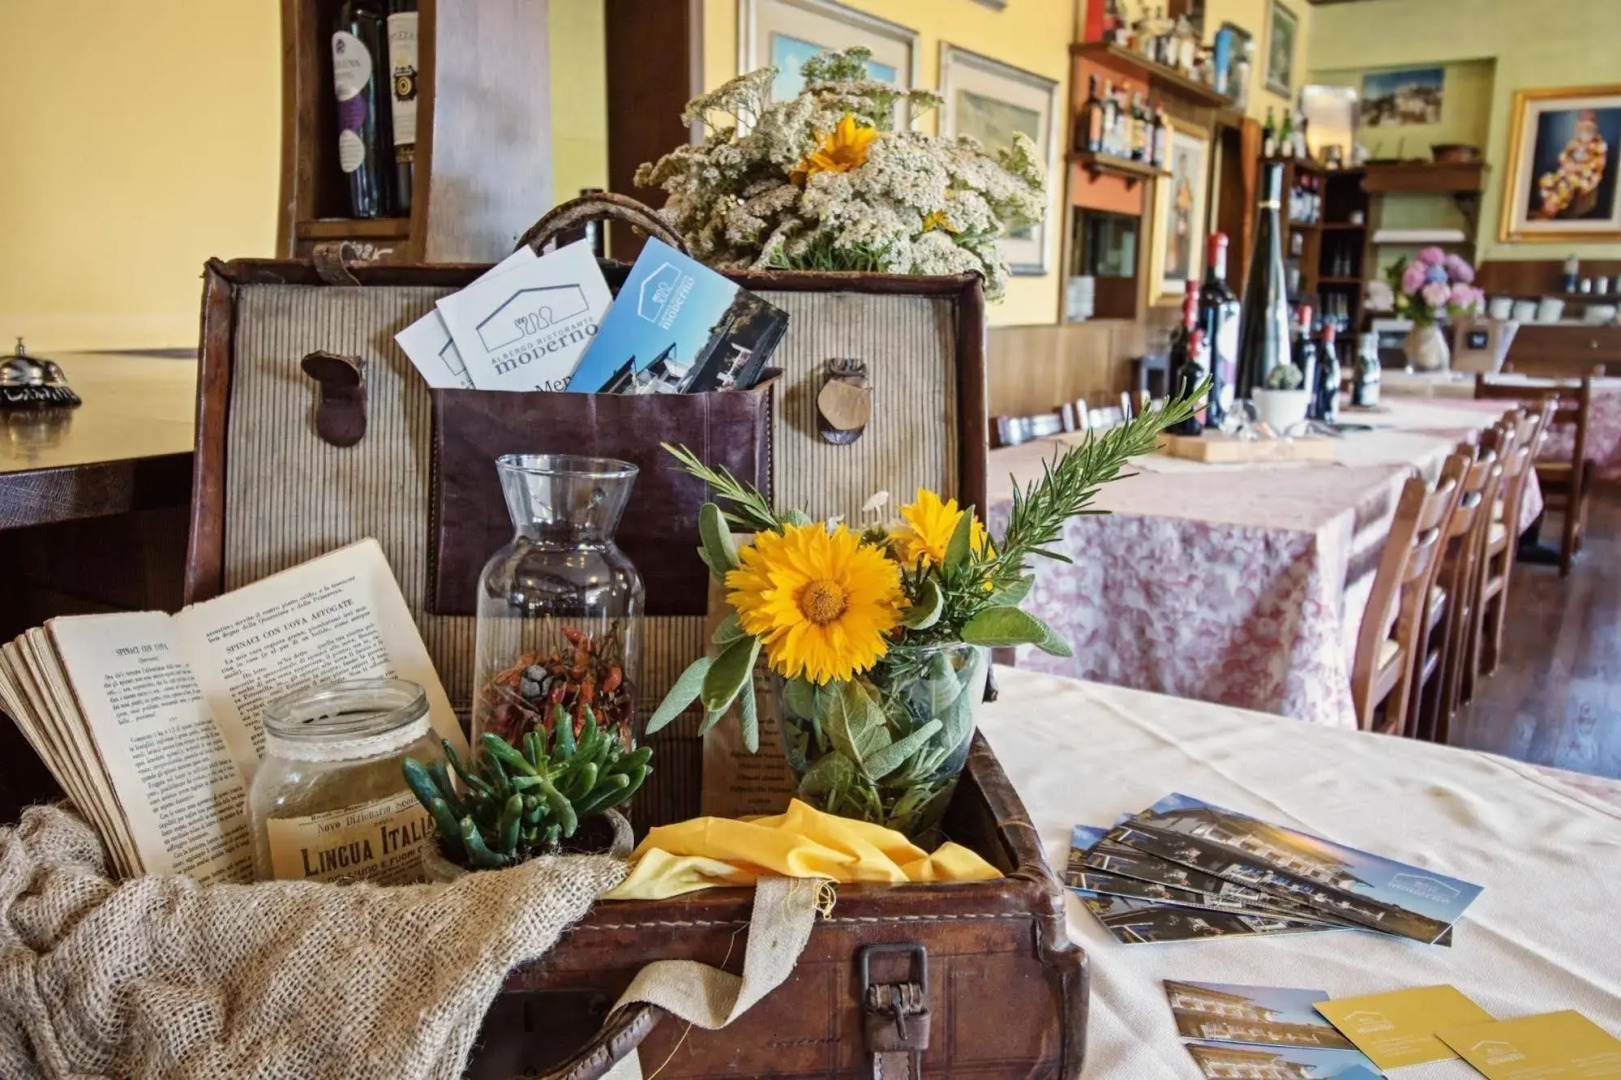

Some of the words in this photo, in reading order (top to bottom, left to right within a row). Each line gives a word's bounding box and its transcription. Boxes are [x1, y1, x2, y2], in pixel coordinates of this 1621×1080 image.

[225, 635, 259, 653] SPINACI
[262, 626, 280, 639] CON
[283, 616, 307, 630] UOVA
[310, 598, 354, 620] AFFOGATE
[317, 821, 342, 834] Novo
[346, 806, 391, 826] Dizionario
[300, 839, 374, 877] LINGUA
